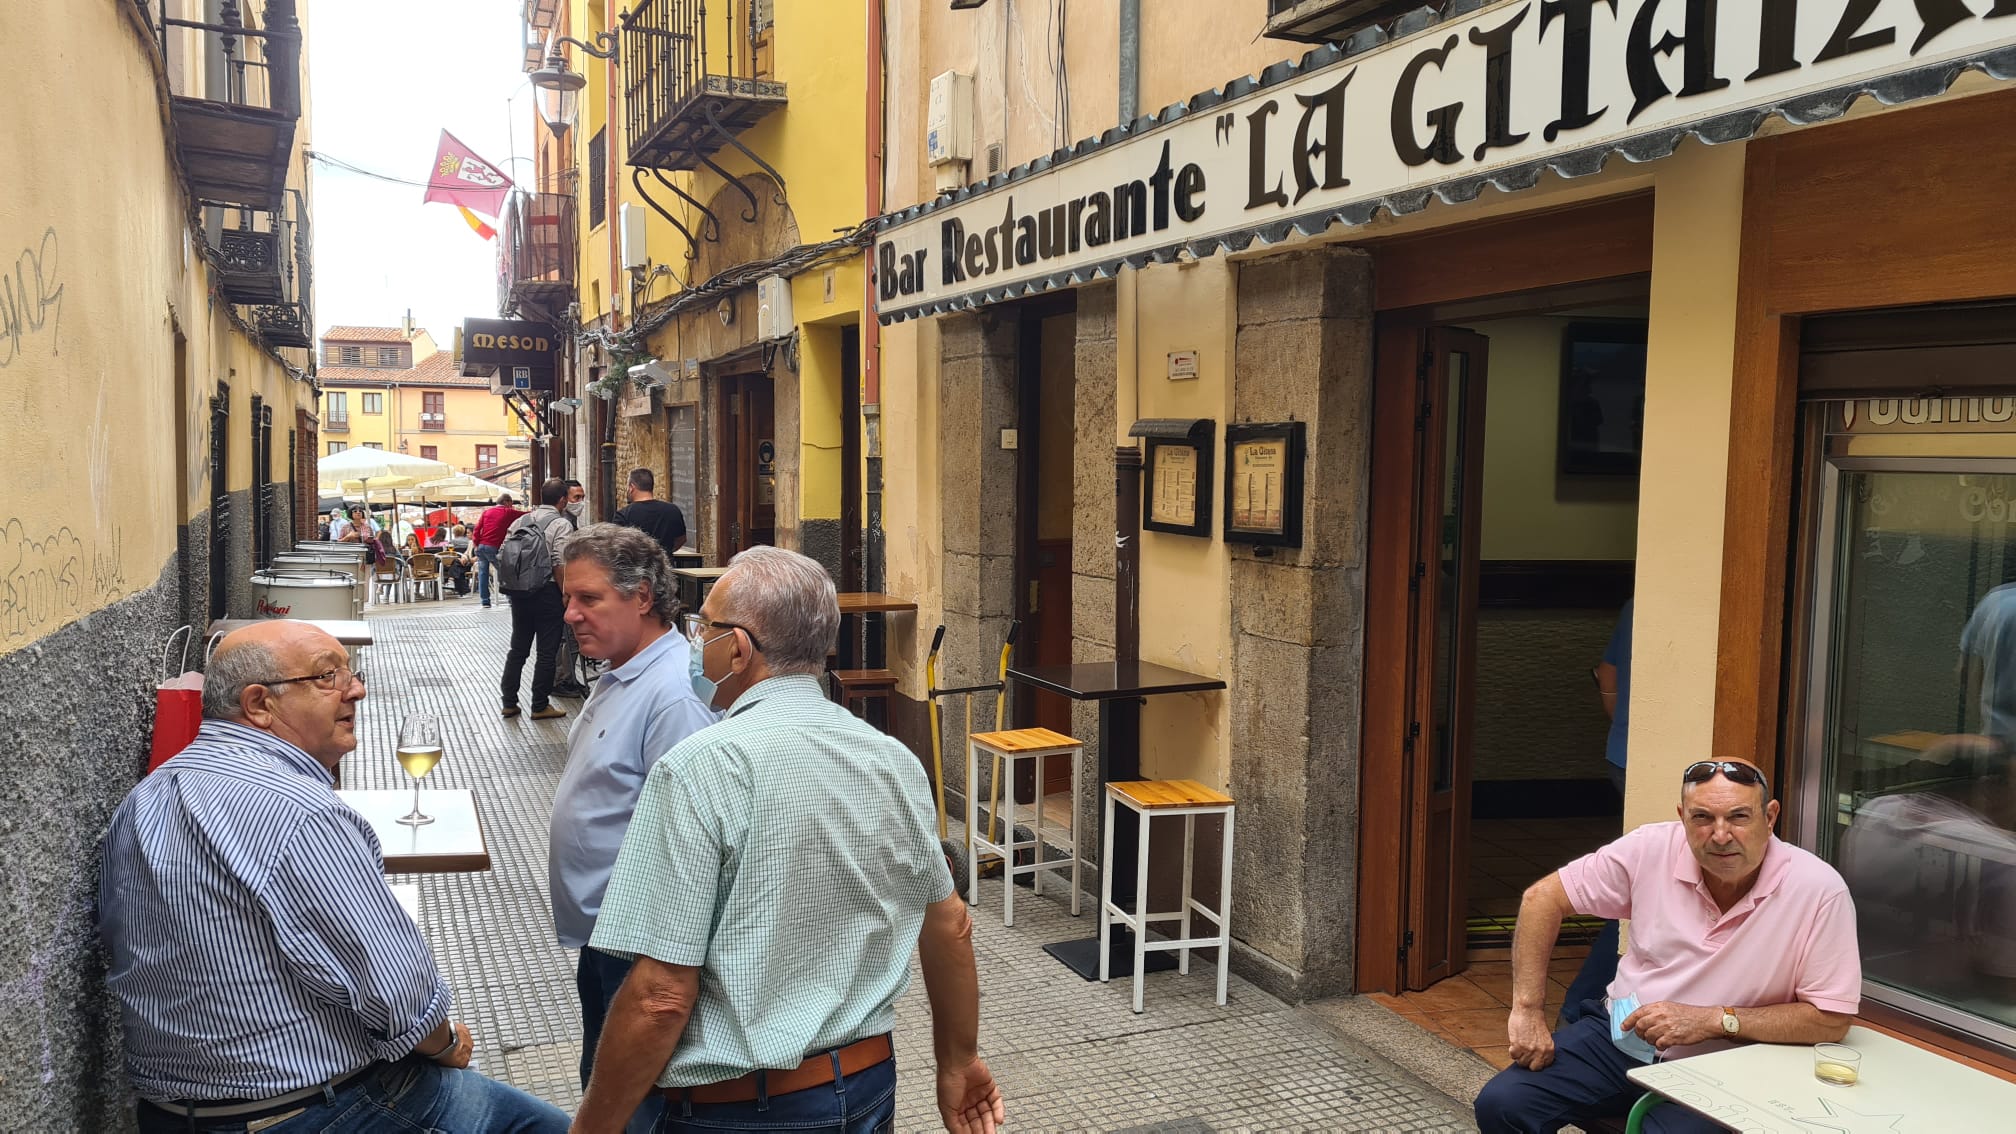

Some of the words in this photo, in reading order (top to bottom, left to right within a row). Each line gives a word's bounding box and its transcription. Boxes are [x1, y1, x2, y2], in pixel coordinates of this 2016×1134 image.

[879, 240, 927, 301] Bar
[942, 139, 1206, 285] Restaurante
[1390, 0, 2016, 166] GITA
